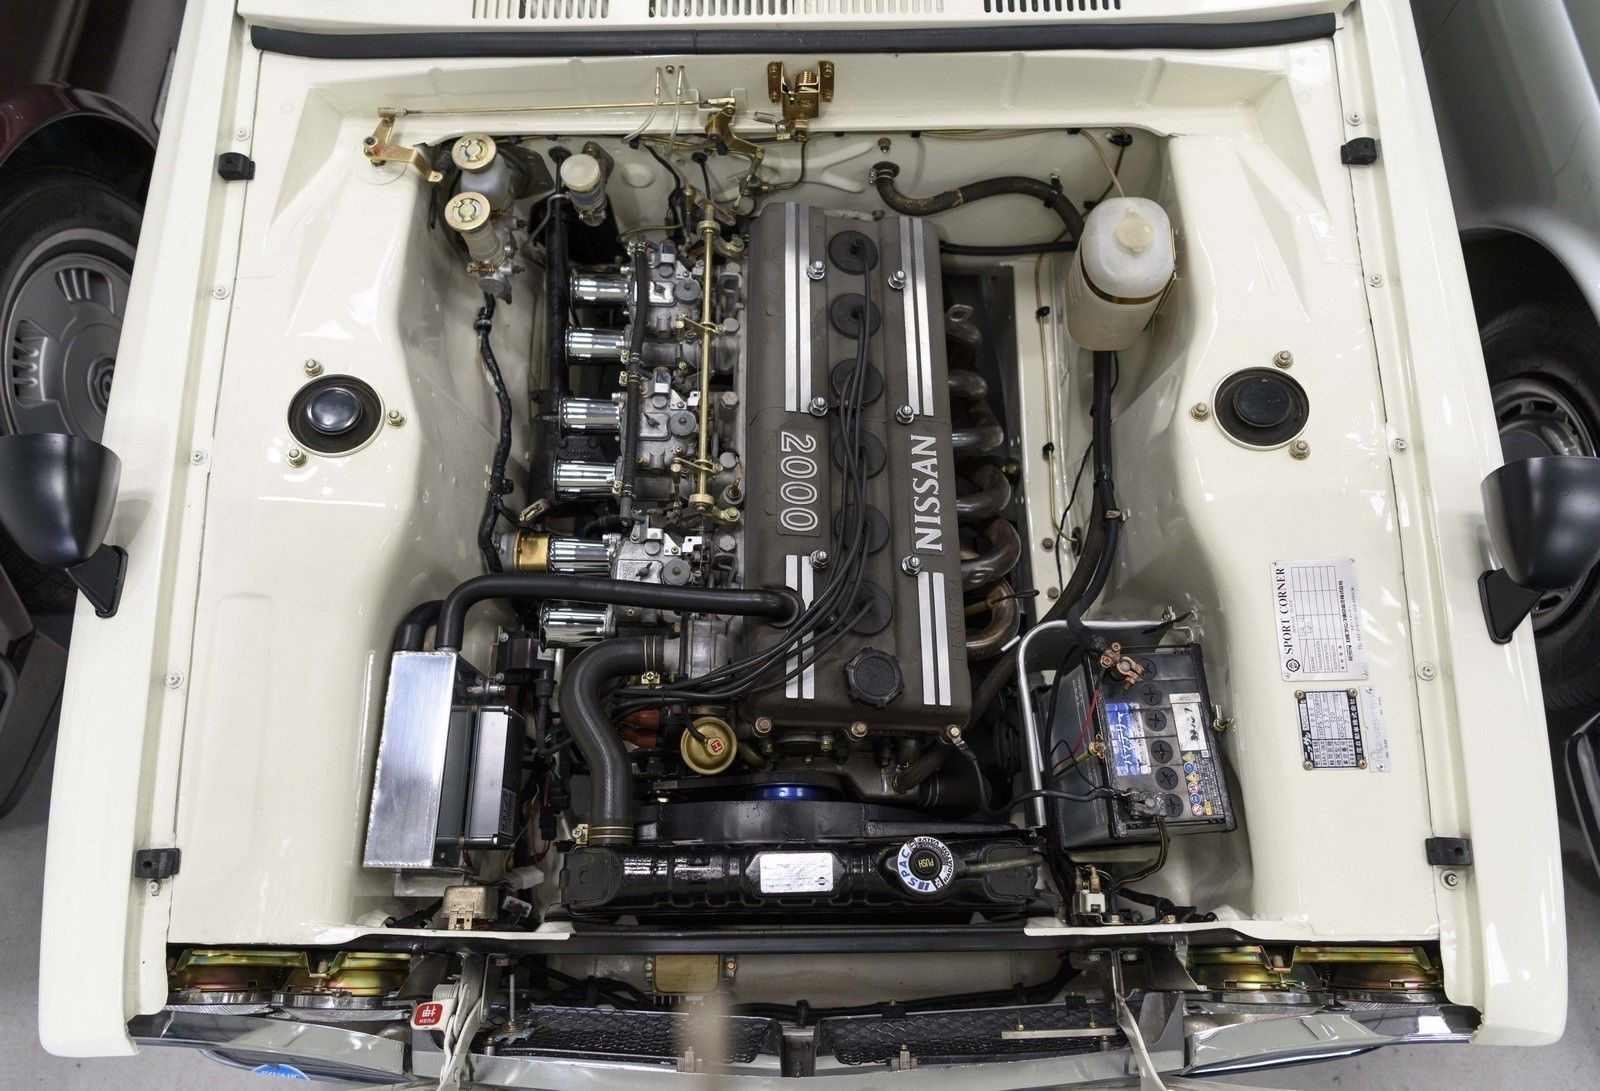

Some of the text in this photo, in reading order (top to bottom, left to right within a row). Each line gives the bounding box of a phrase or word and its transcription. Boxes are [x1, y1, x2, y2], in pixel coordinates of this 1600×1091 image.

[781, 431, 818, 532] 2000
[911, 435, 943, 551] NISSAN
[1276, 568, 1293, 654] SPORT CORNER
[918, 858, 934, 868] PUSH
